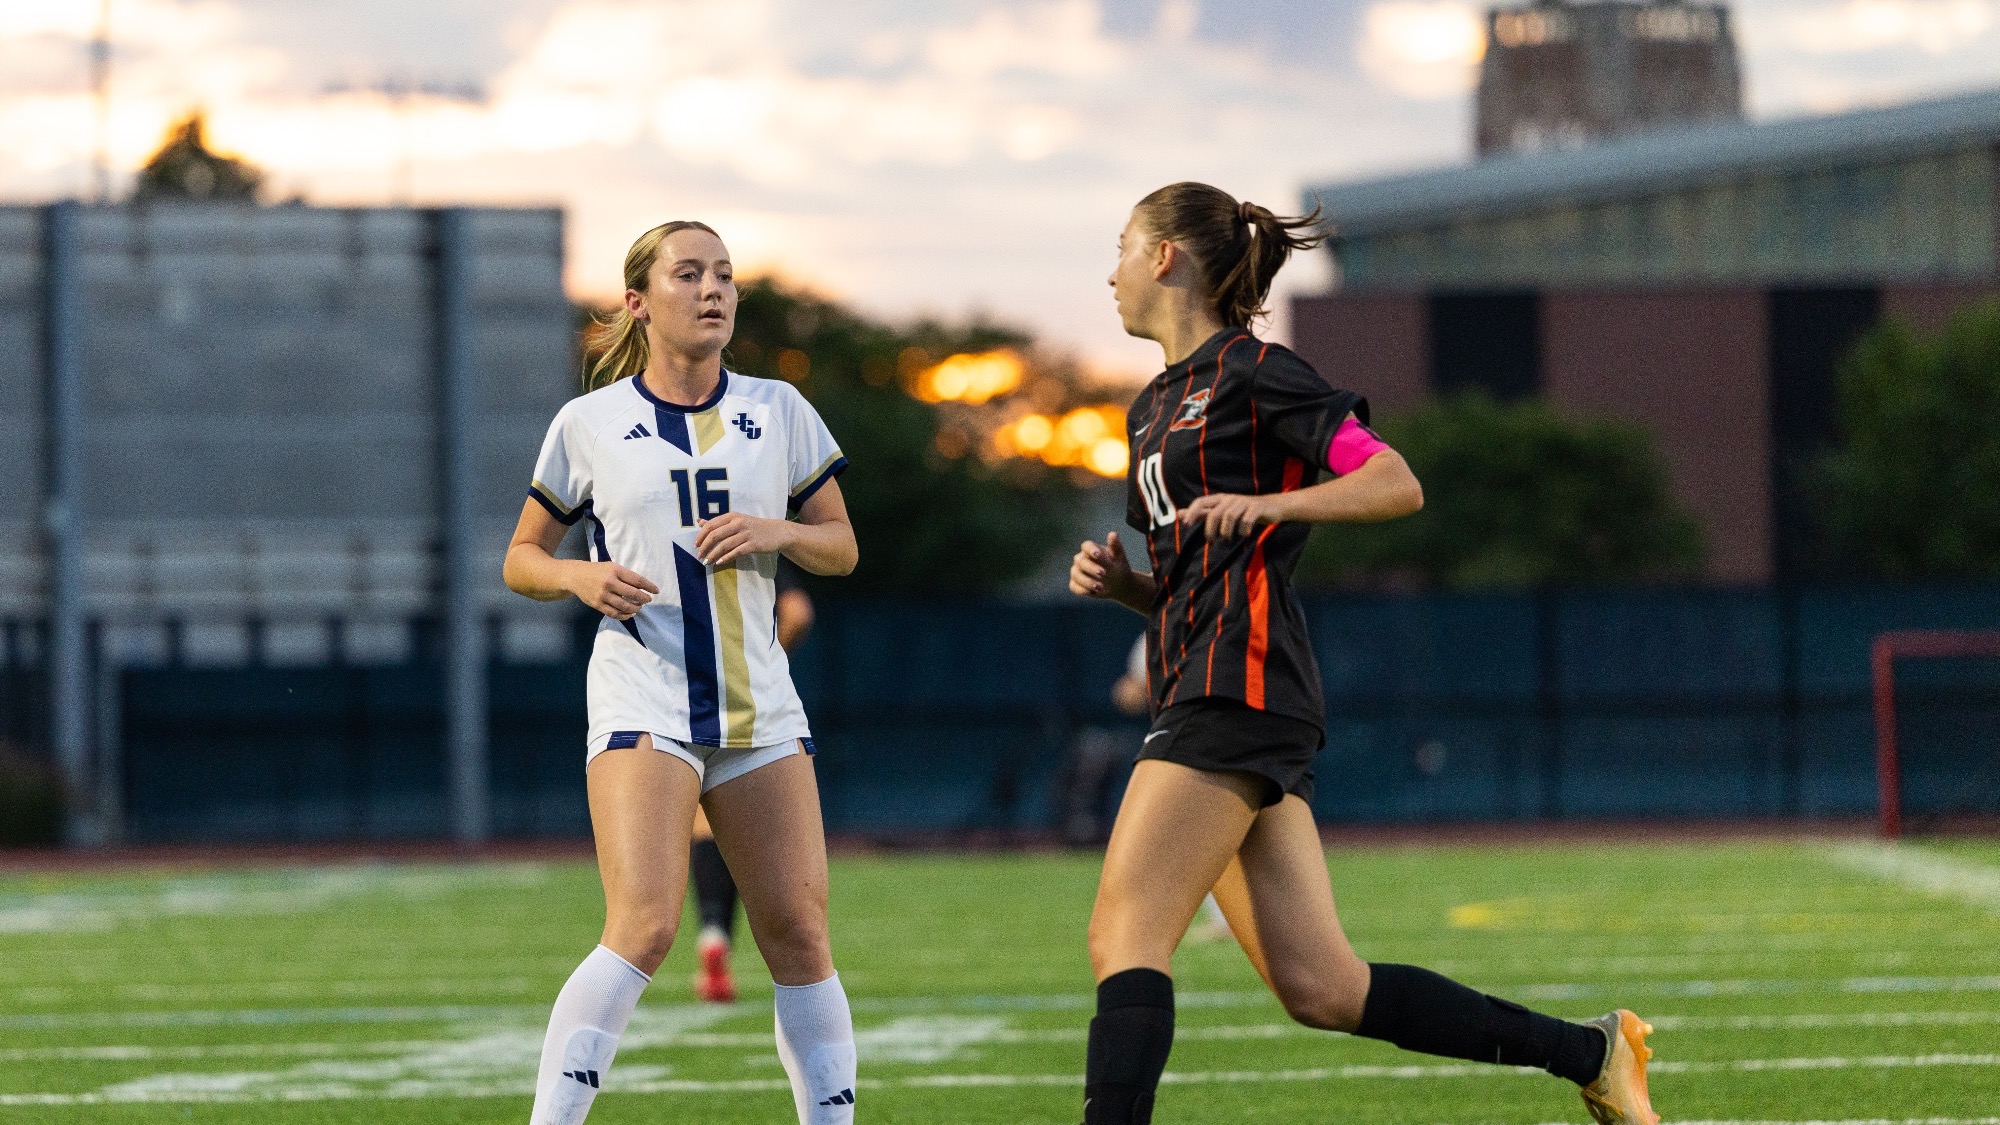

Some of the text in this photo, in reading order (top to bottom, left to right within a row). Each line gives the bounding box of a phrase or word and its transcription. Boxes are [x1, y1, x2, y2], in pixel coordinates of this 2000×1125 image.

[731, 412, 762, 440] JCU
[669, 467, 731, 528] 16
[1137, 452, 1177, 531] 10
